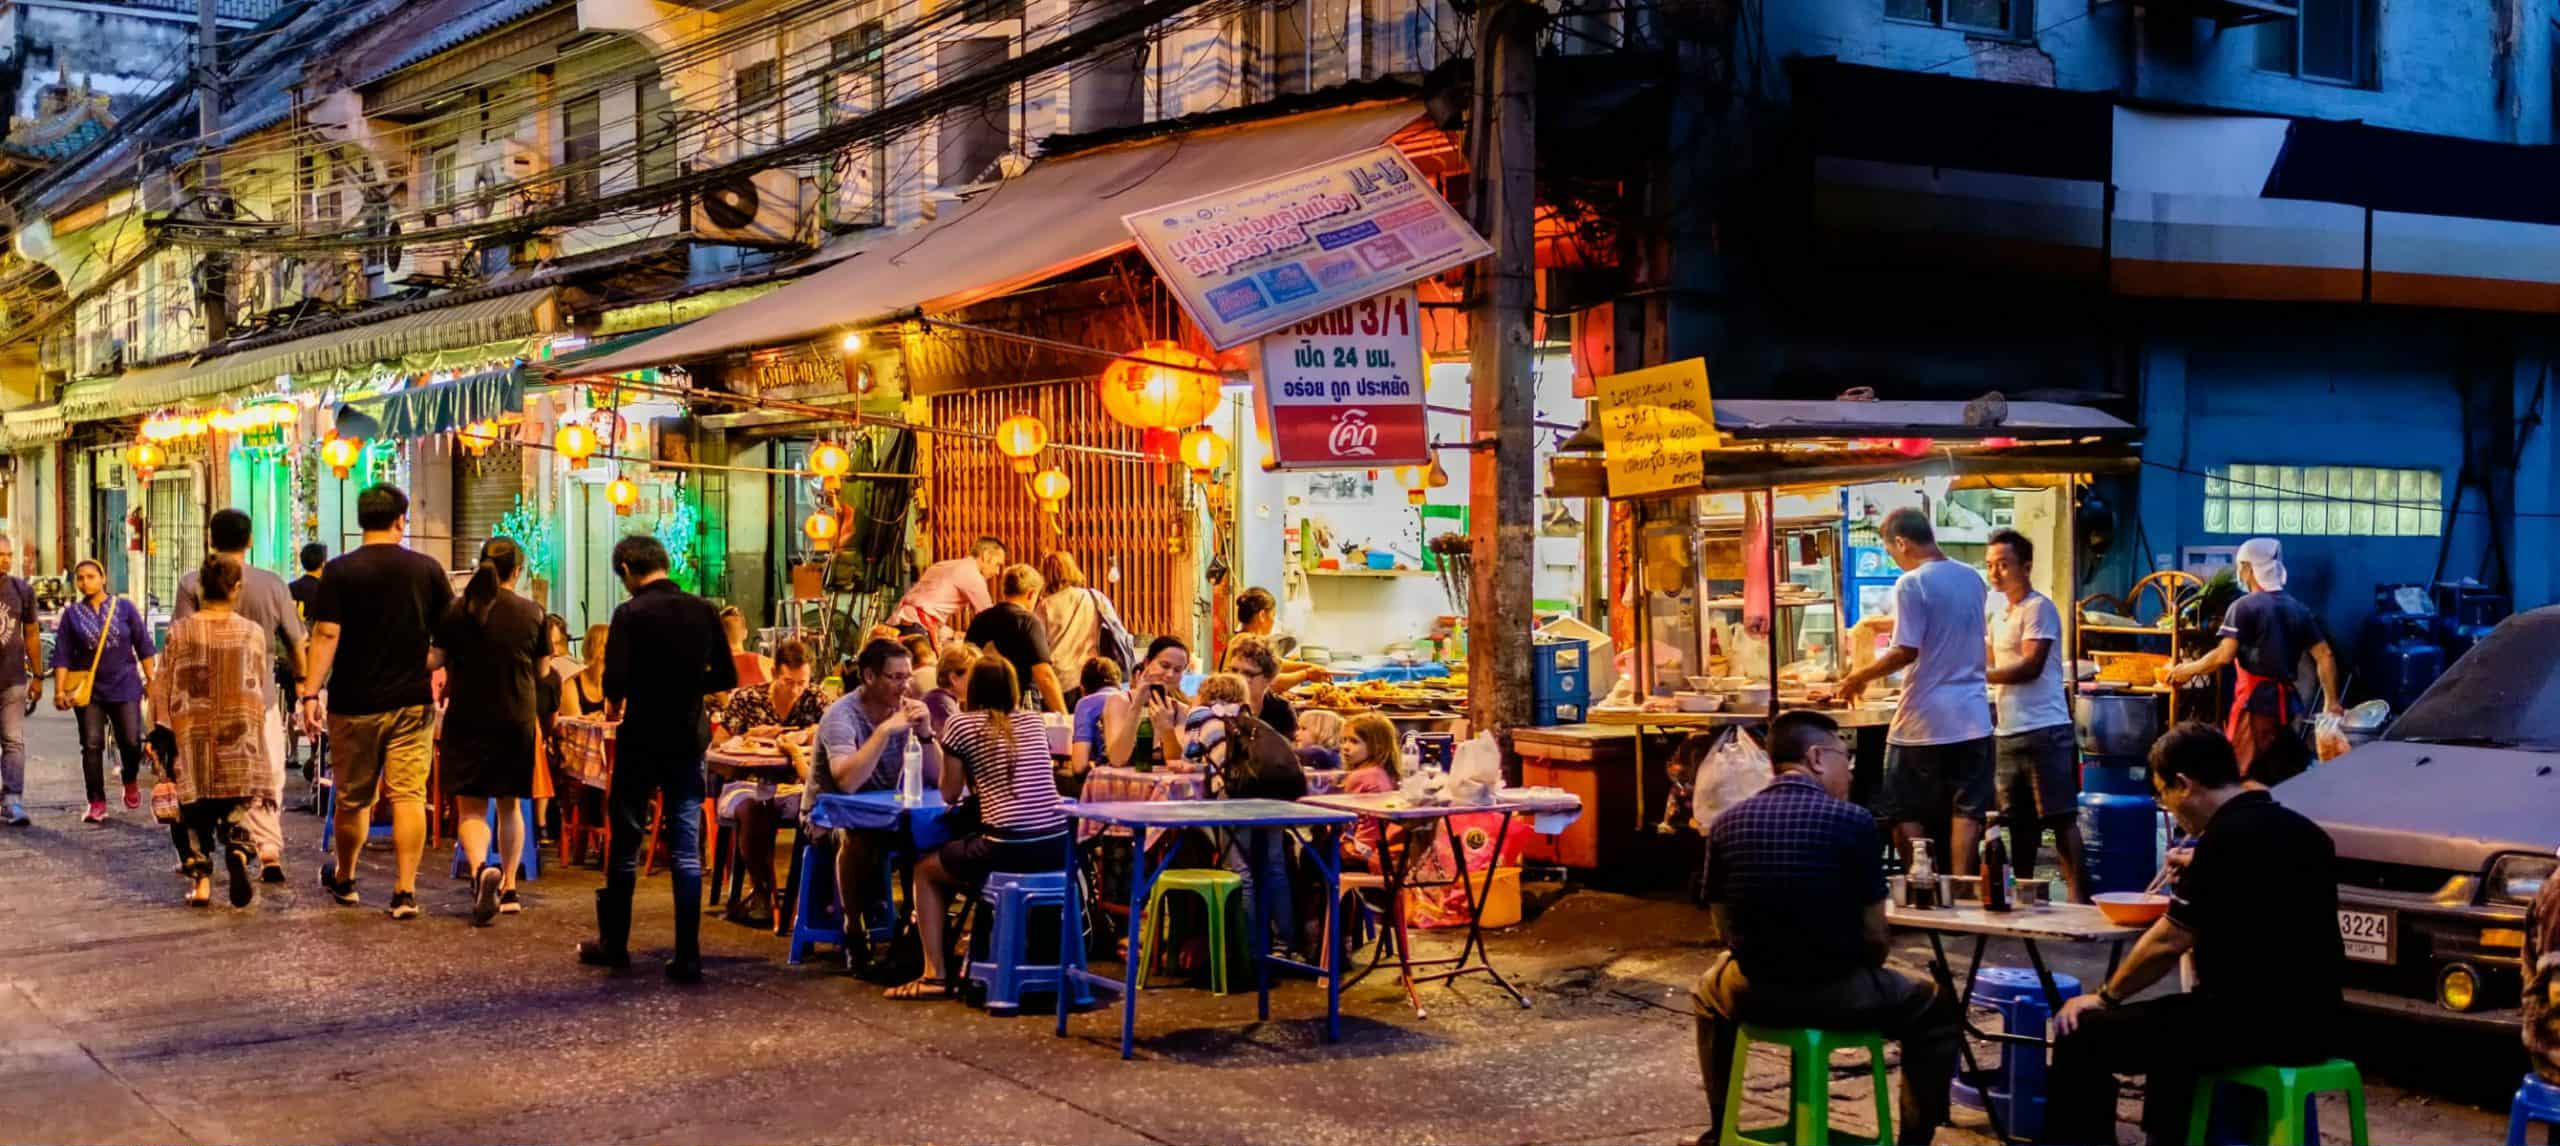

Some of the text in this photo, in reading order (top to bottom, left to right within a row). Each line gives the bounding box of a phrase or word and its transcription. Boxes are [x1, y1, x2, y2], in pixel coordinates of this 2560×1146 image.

[1359, 296, 1409, 336] 3/1
[1294, 340, 1396, 368] เปิด 24 ชม.
[1284, 375, 1410, 402] อร่อย ถูก ประหยัด
[2342, 914, 2385, 937] 3224
